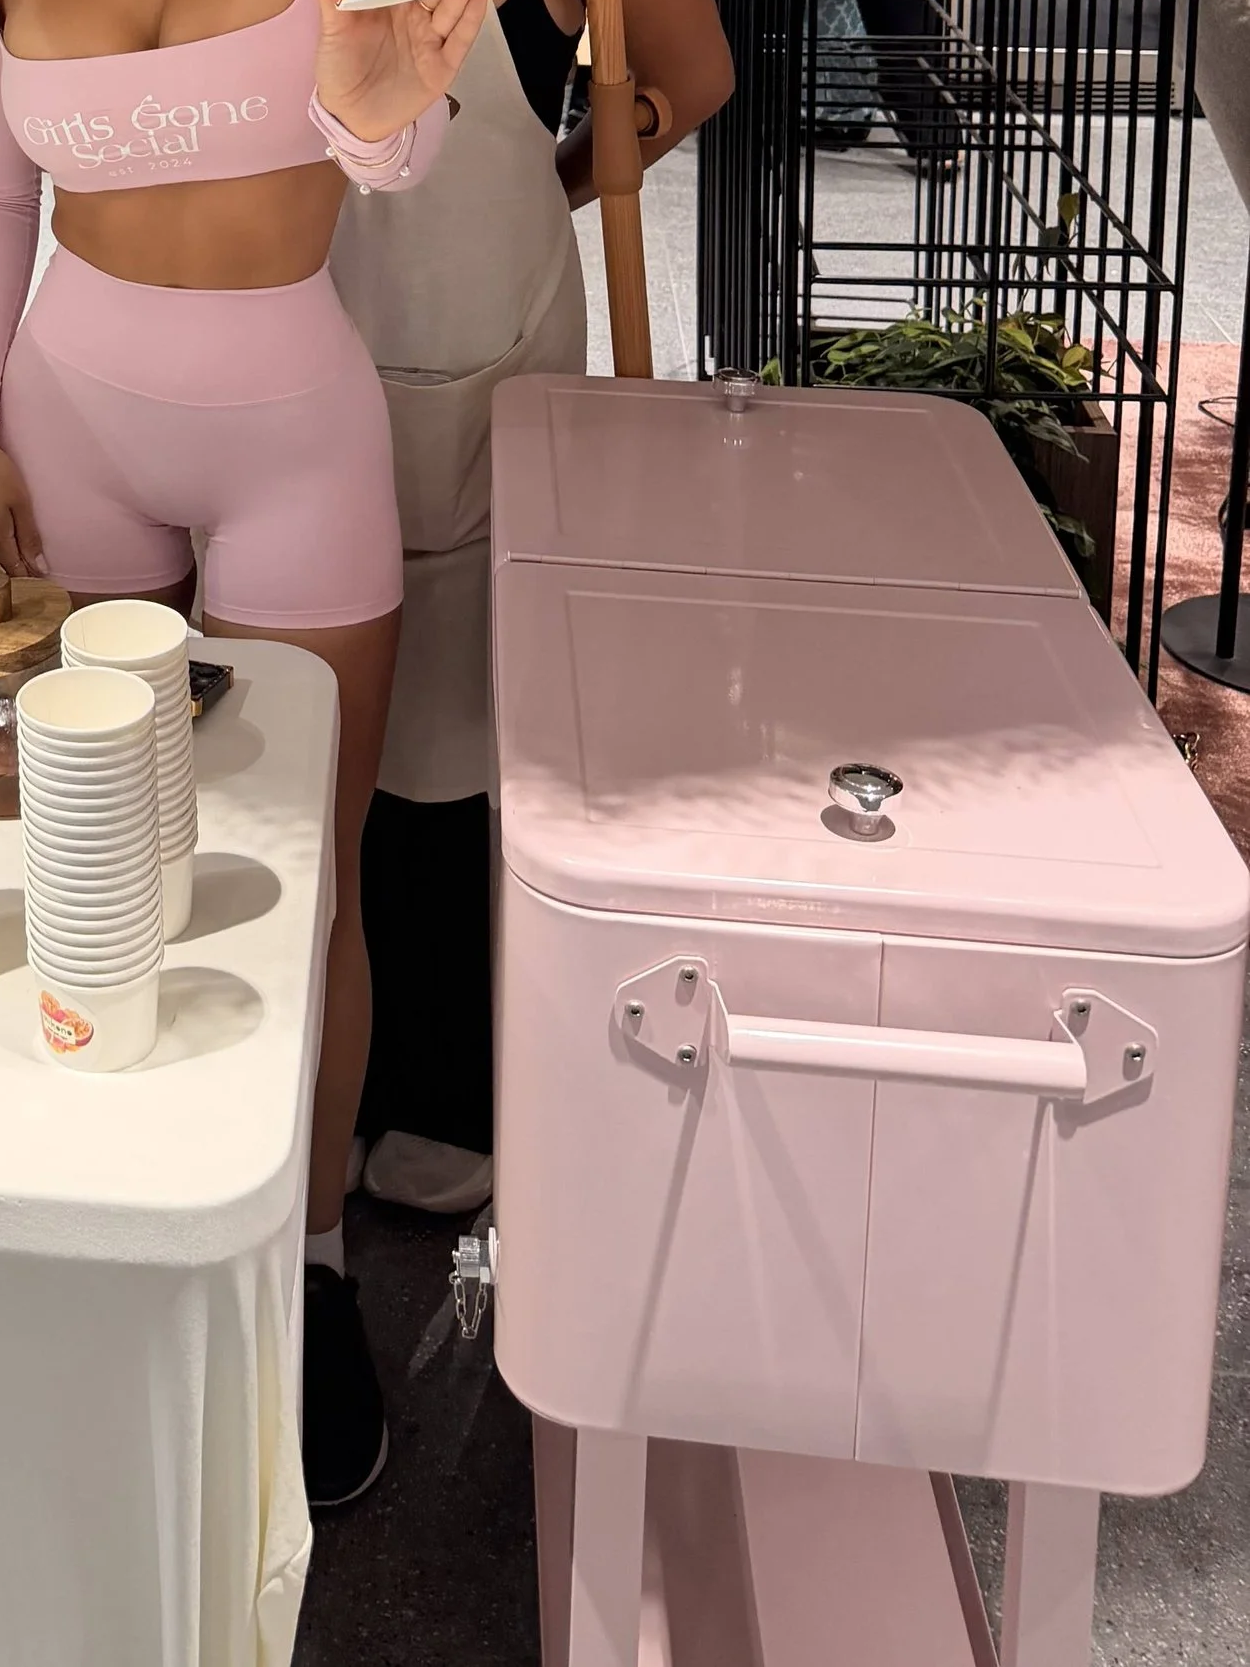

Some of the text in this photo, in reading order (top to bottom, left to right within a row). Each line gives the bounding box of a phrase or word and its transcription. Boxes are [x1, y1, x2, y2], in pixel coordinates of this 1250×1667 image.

[23, 95, 268, 146] Girls Gone
[71, 125, 200, 169] Social
[148, 157, 192, 170] 2024
